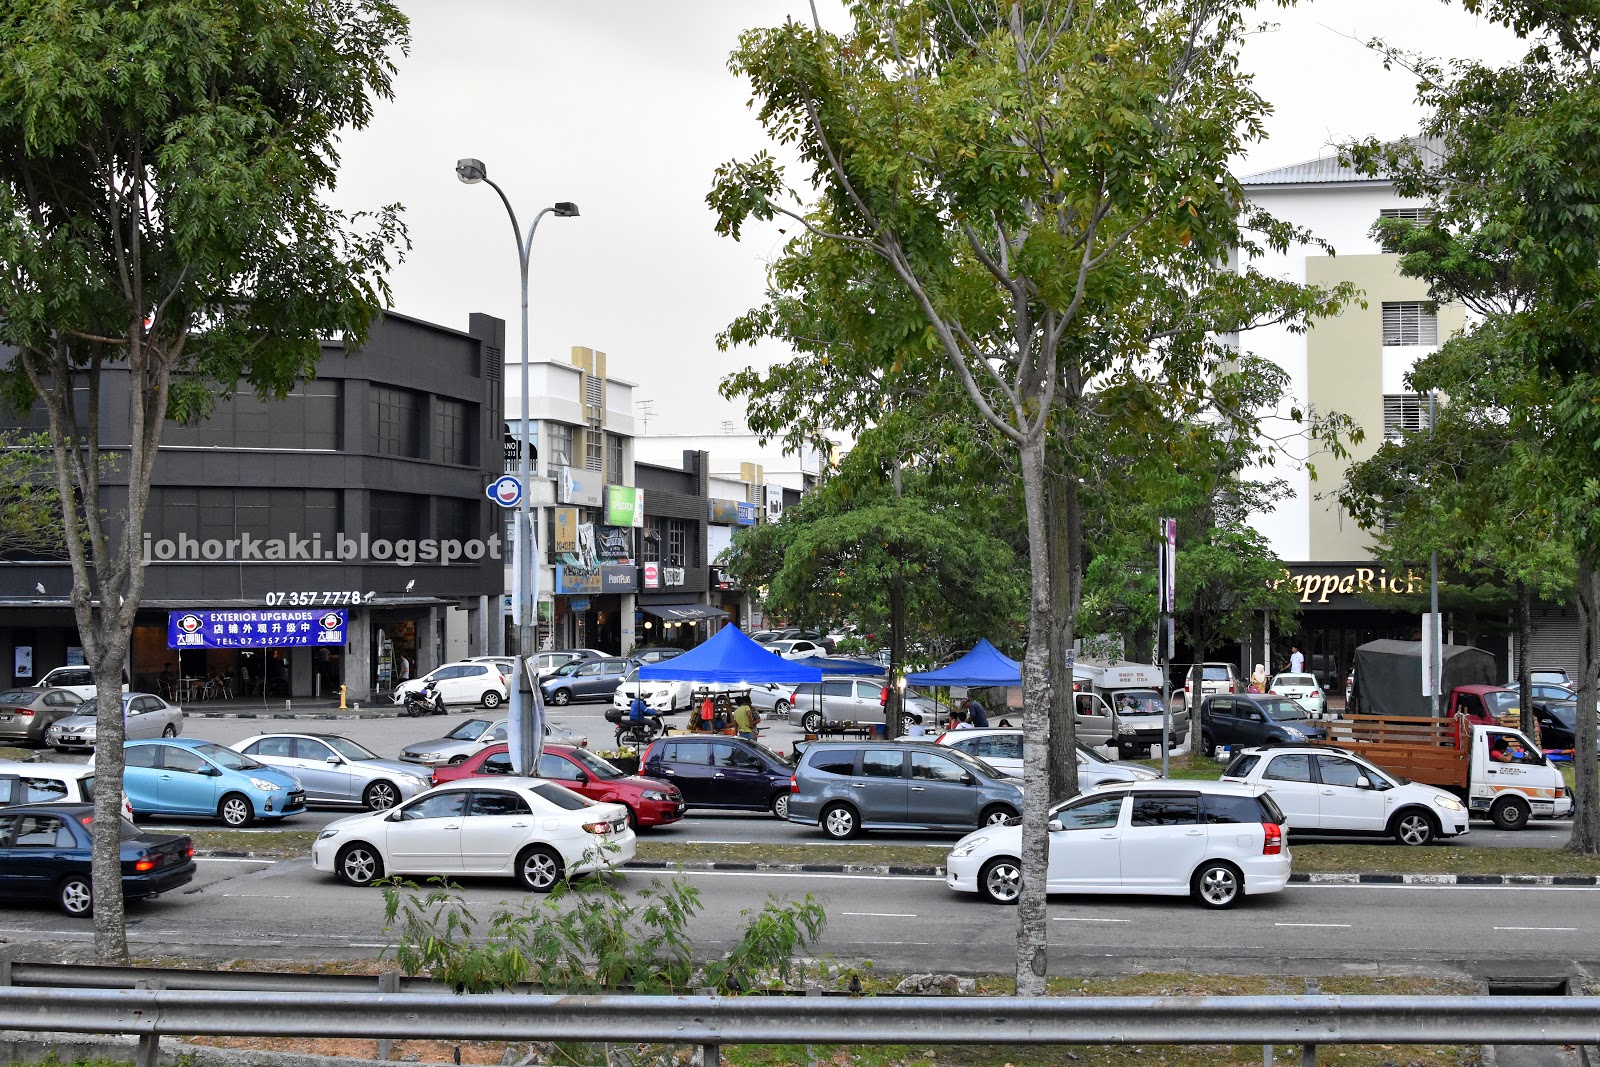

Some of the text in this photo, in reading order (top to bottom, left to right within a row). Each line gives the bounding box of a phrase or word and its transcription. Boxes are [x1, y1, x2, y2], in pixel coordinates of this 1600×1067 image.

[265, 590, 361, 606] 07 357 7778
[210, 612, 313, 622] EXTERIOR UPGRADES
[213, 623, 310, 634] 店铺外观升级中
